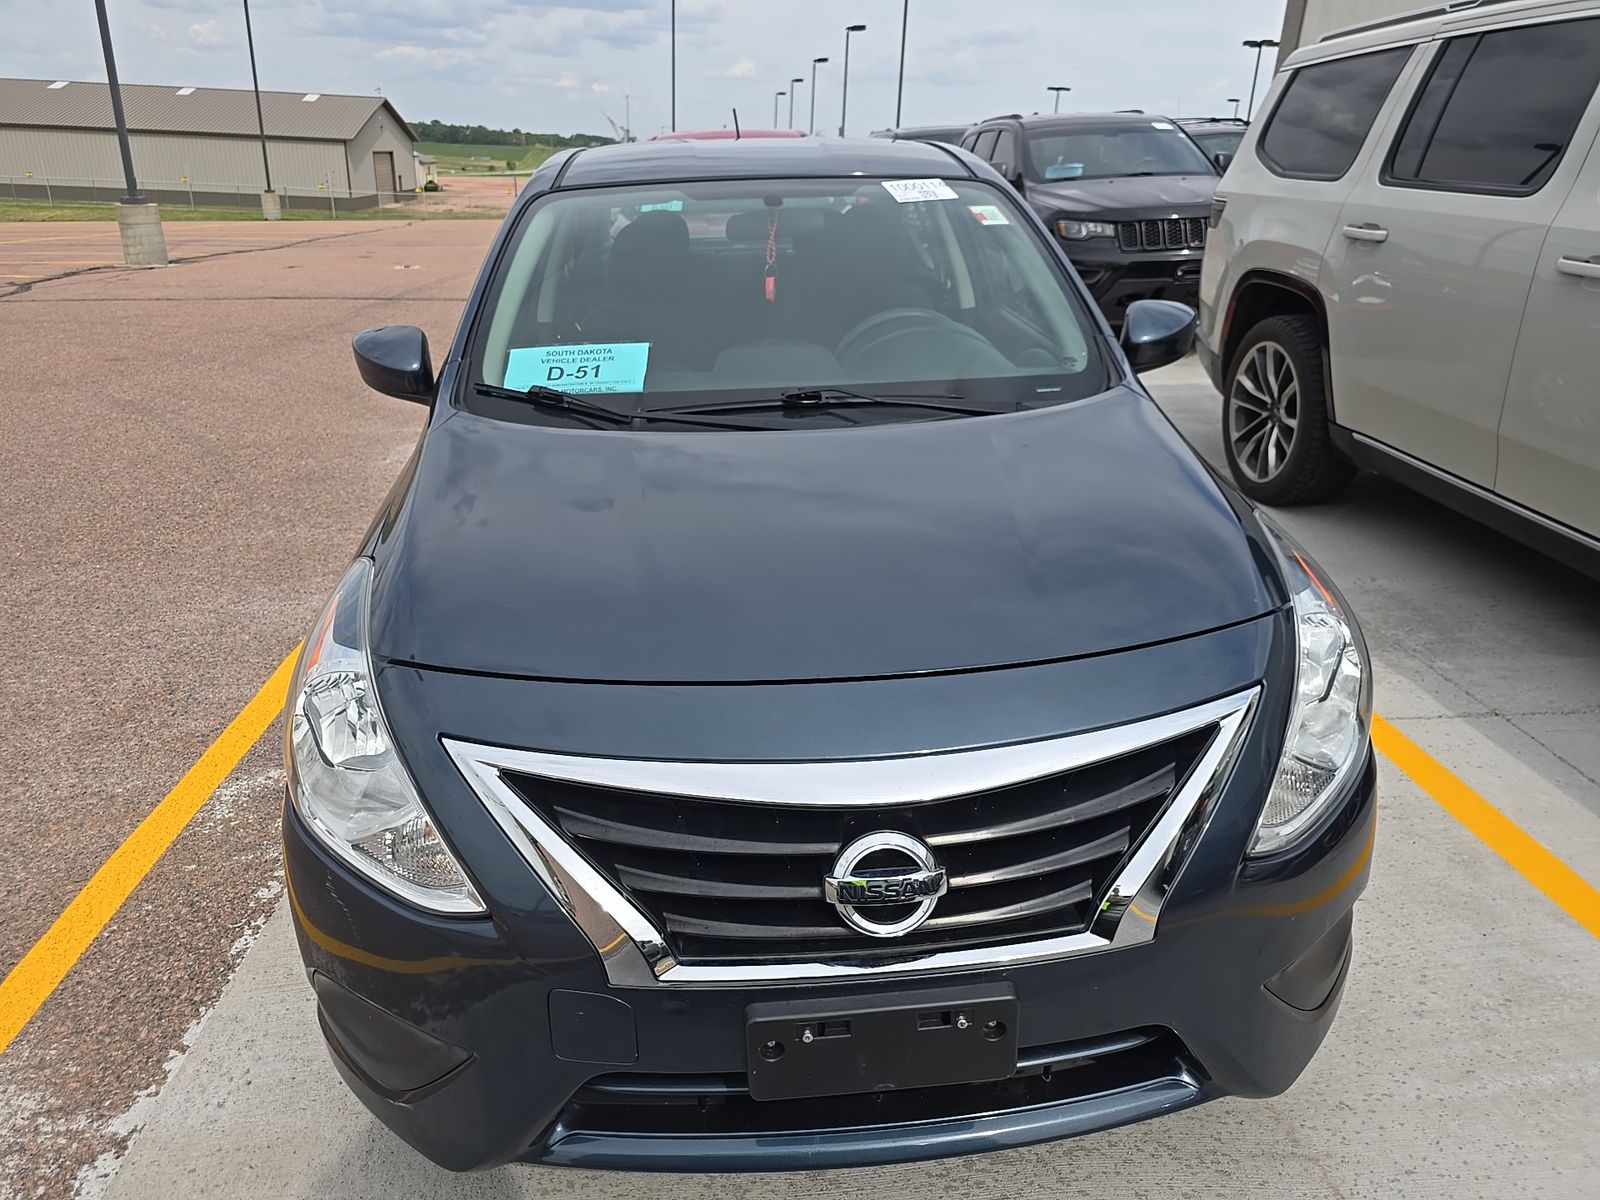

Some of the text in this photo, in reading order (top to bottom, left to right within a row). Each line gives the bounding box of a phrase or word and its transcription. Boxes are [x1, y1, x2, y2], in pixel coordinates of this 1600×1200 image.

[578, 348, 612, 356] DAKOTA
[546, 364, 601, 381] D-51
[838, 874, 943, 902] NISSAN
